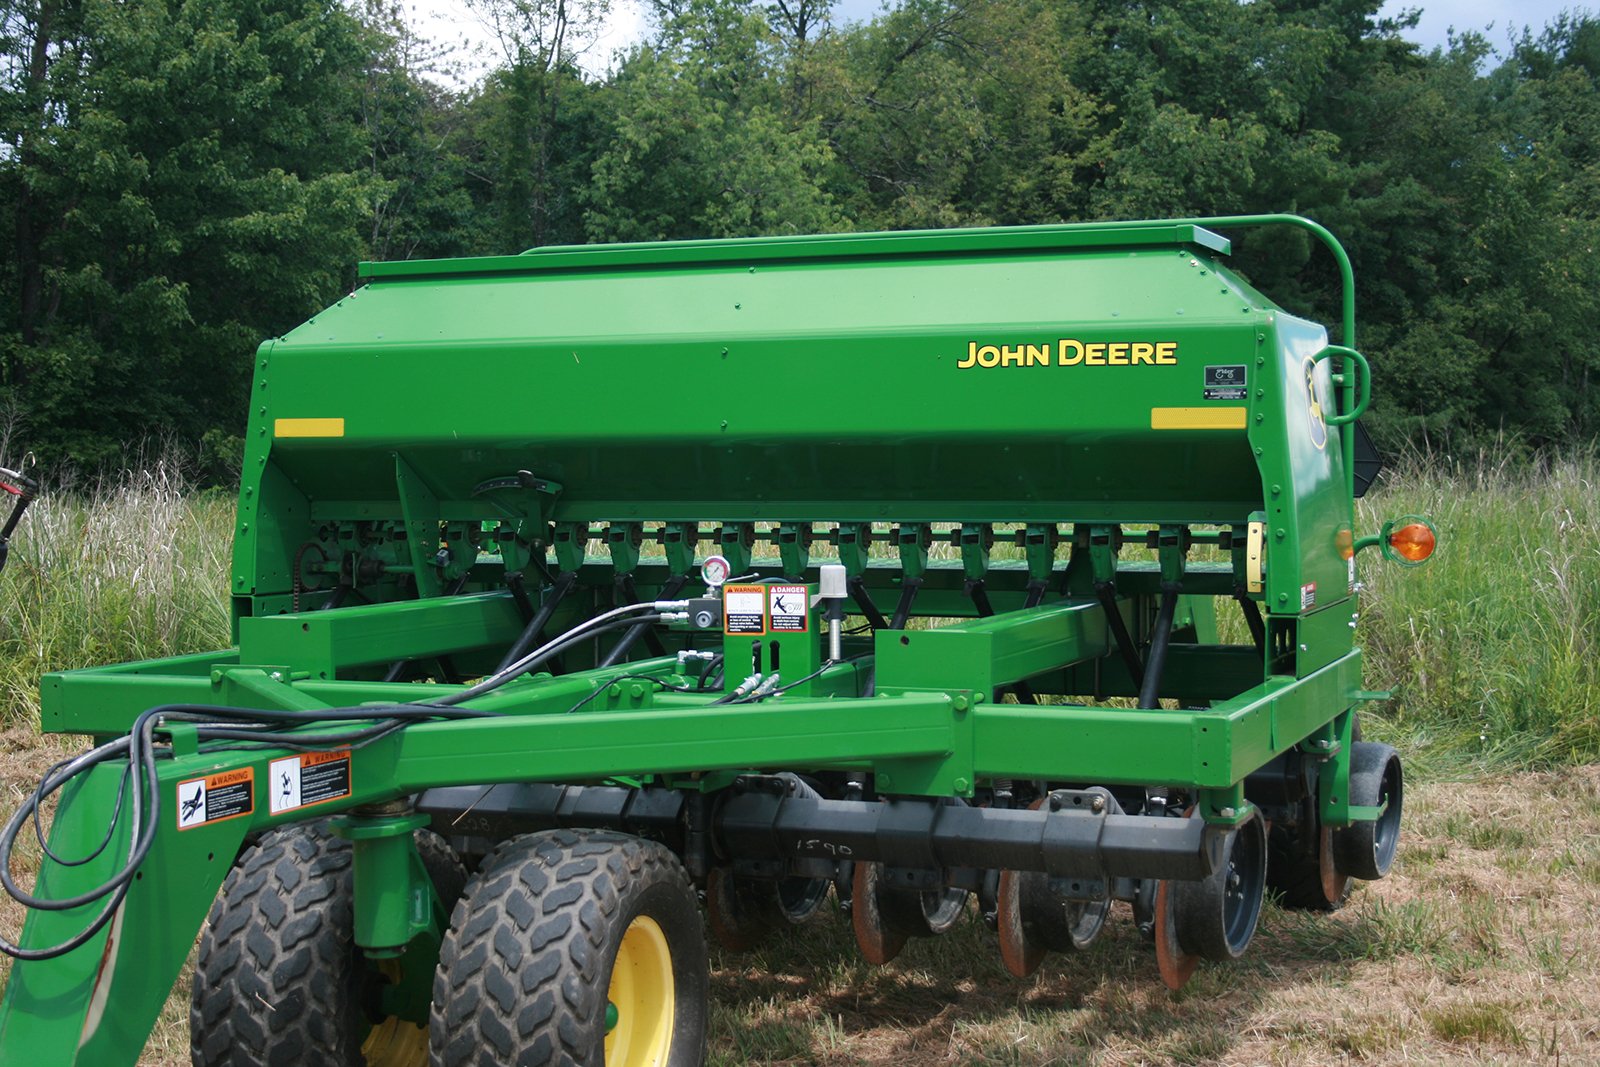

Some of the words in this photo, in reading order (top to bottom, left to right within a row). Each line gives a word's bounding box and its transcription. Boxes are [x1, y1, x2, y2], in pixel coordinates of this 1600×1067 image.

[957, 341, 1050, 369] JOHN
[1058, 339, 1177, 366] DEERE
[314, 750, 346, 764] WARNING
[217, 770, 248, 785] WARNING
